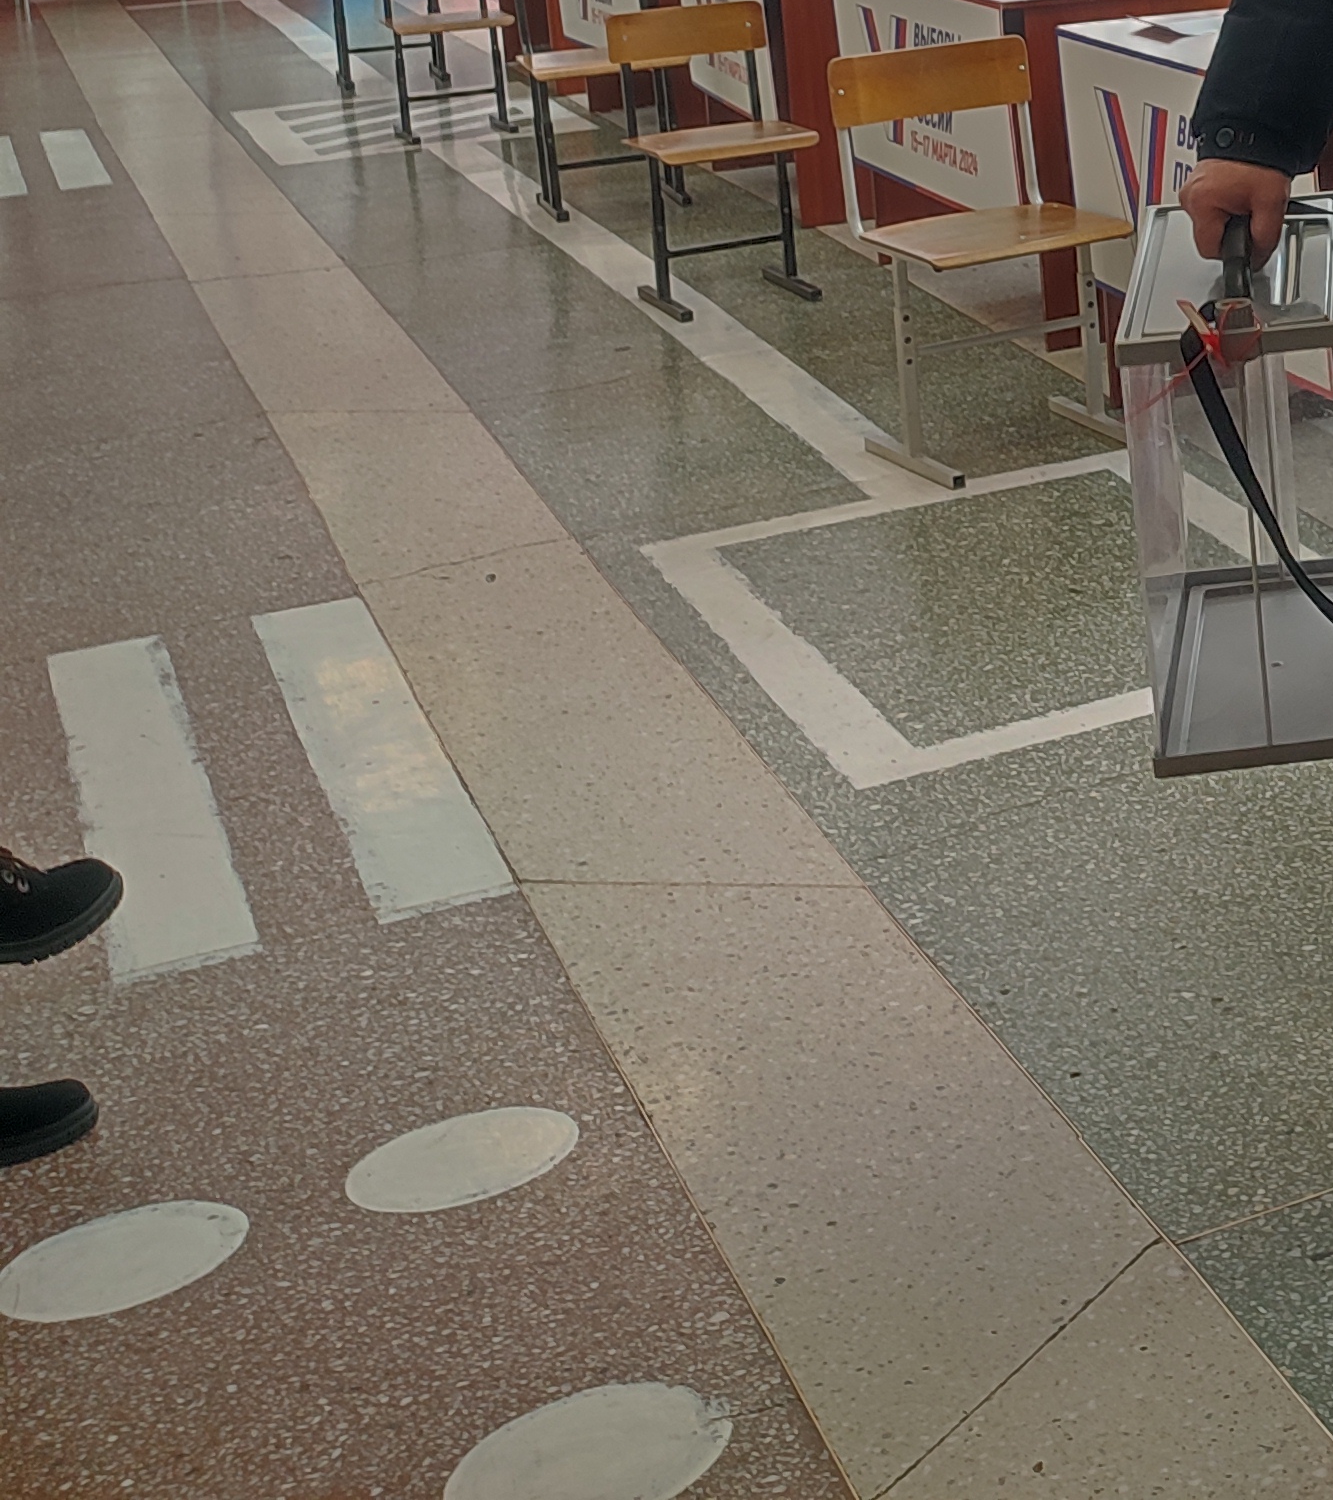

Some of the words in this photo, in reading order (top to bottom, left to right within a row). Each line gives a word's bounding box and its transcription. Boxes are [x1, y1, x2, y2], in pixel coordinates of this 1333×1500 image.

[913, 22, 962, 48] ВЫБО
[910, 111, 953, 135] ССИИ
[931, 136, 958, 169] МАРТА
[958, 148, 979, 178] 2024
